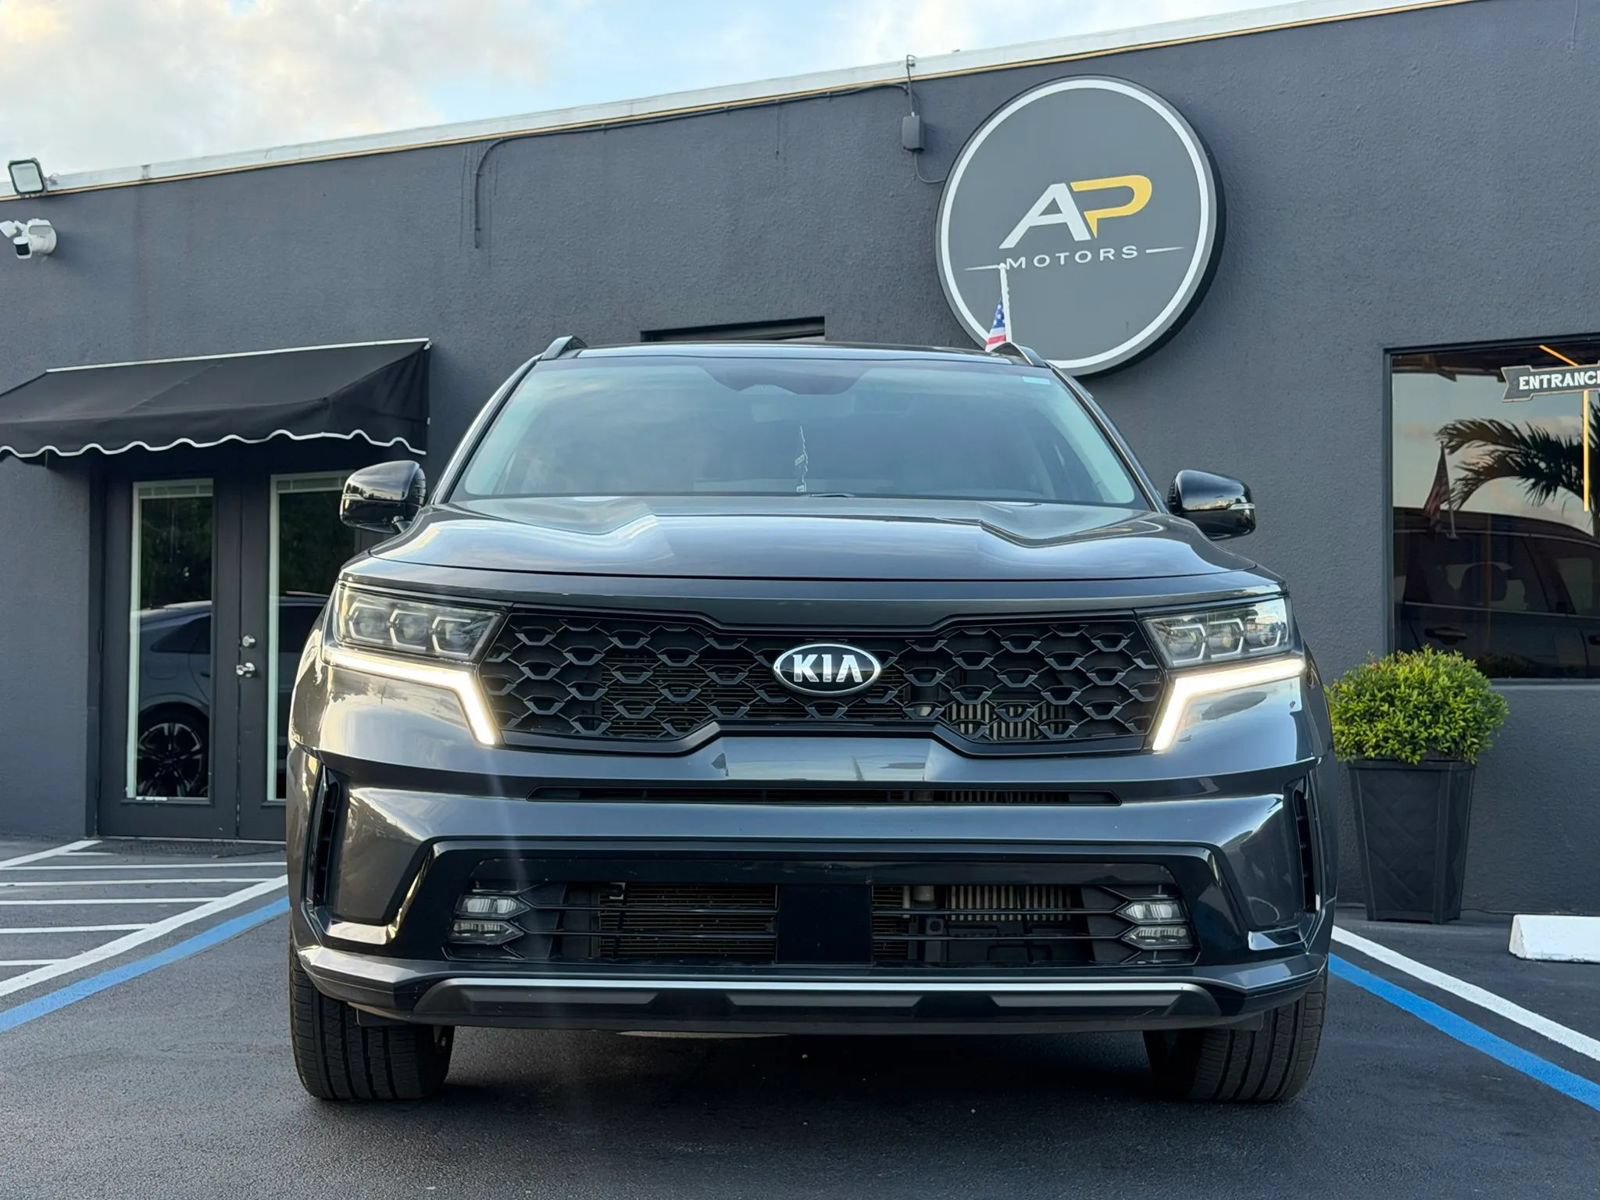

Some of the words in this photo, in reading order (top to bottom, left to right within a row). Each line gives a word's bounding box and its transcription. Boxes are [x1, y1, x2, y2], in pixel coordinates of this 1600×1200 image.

[999, 174, 1153, 249] AP
[1005, 245, 1139, 270] MOTORS
[792, 653, 864, 683] KIA
